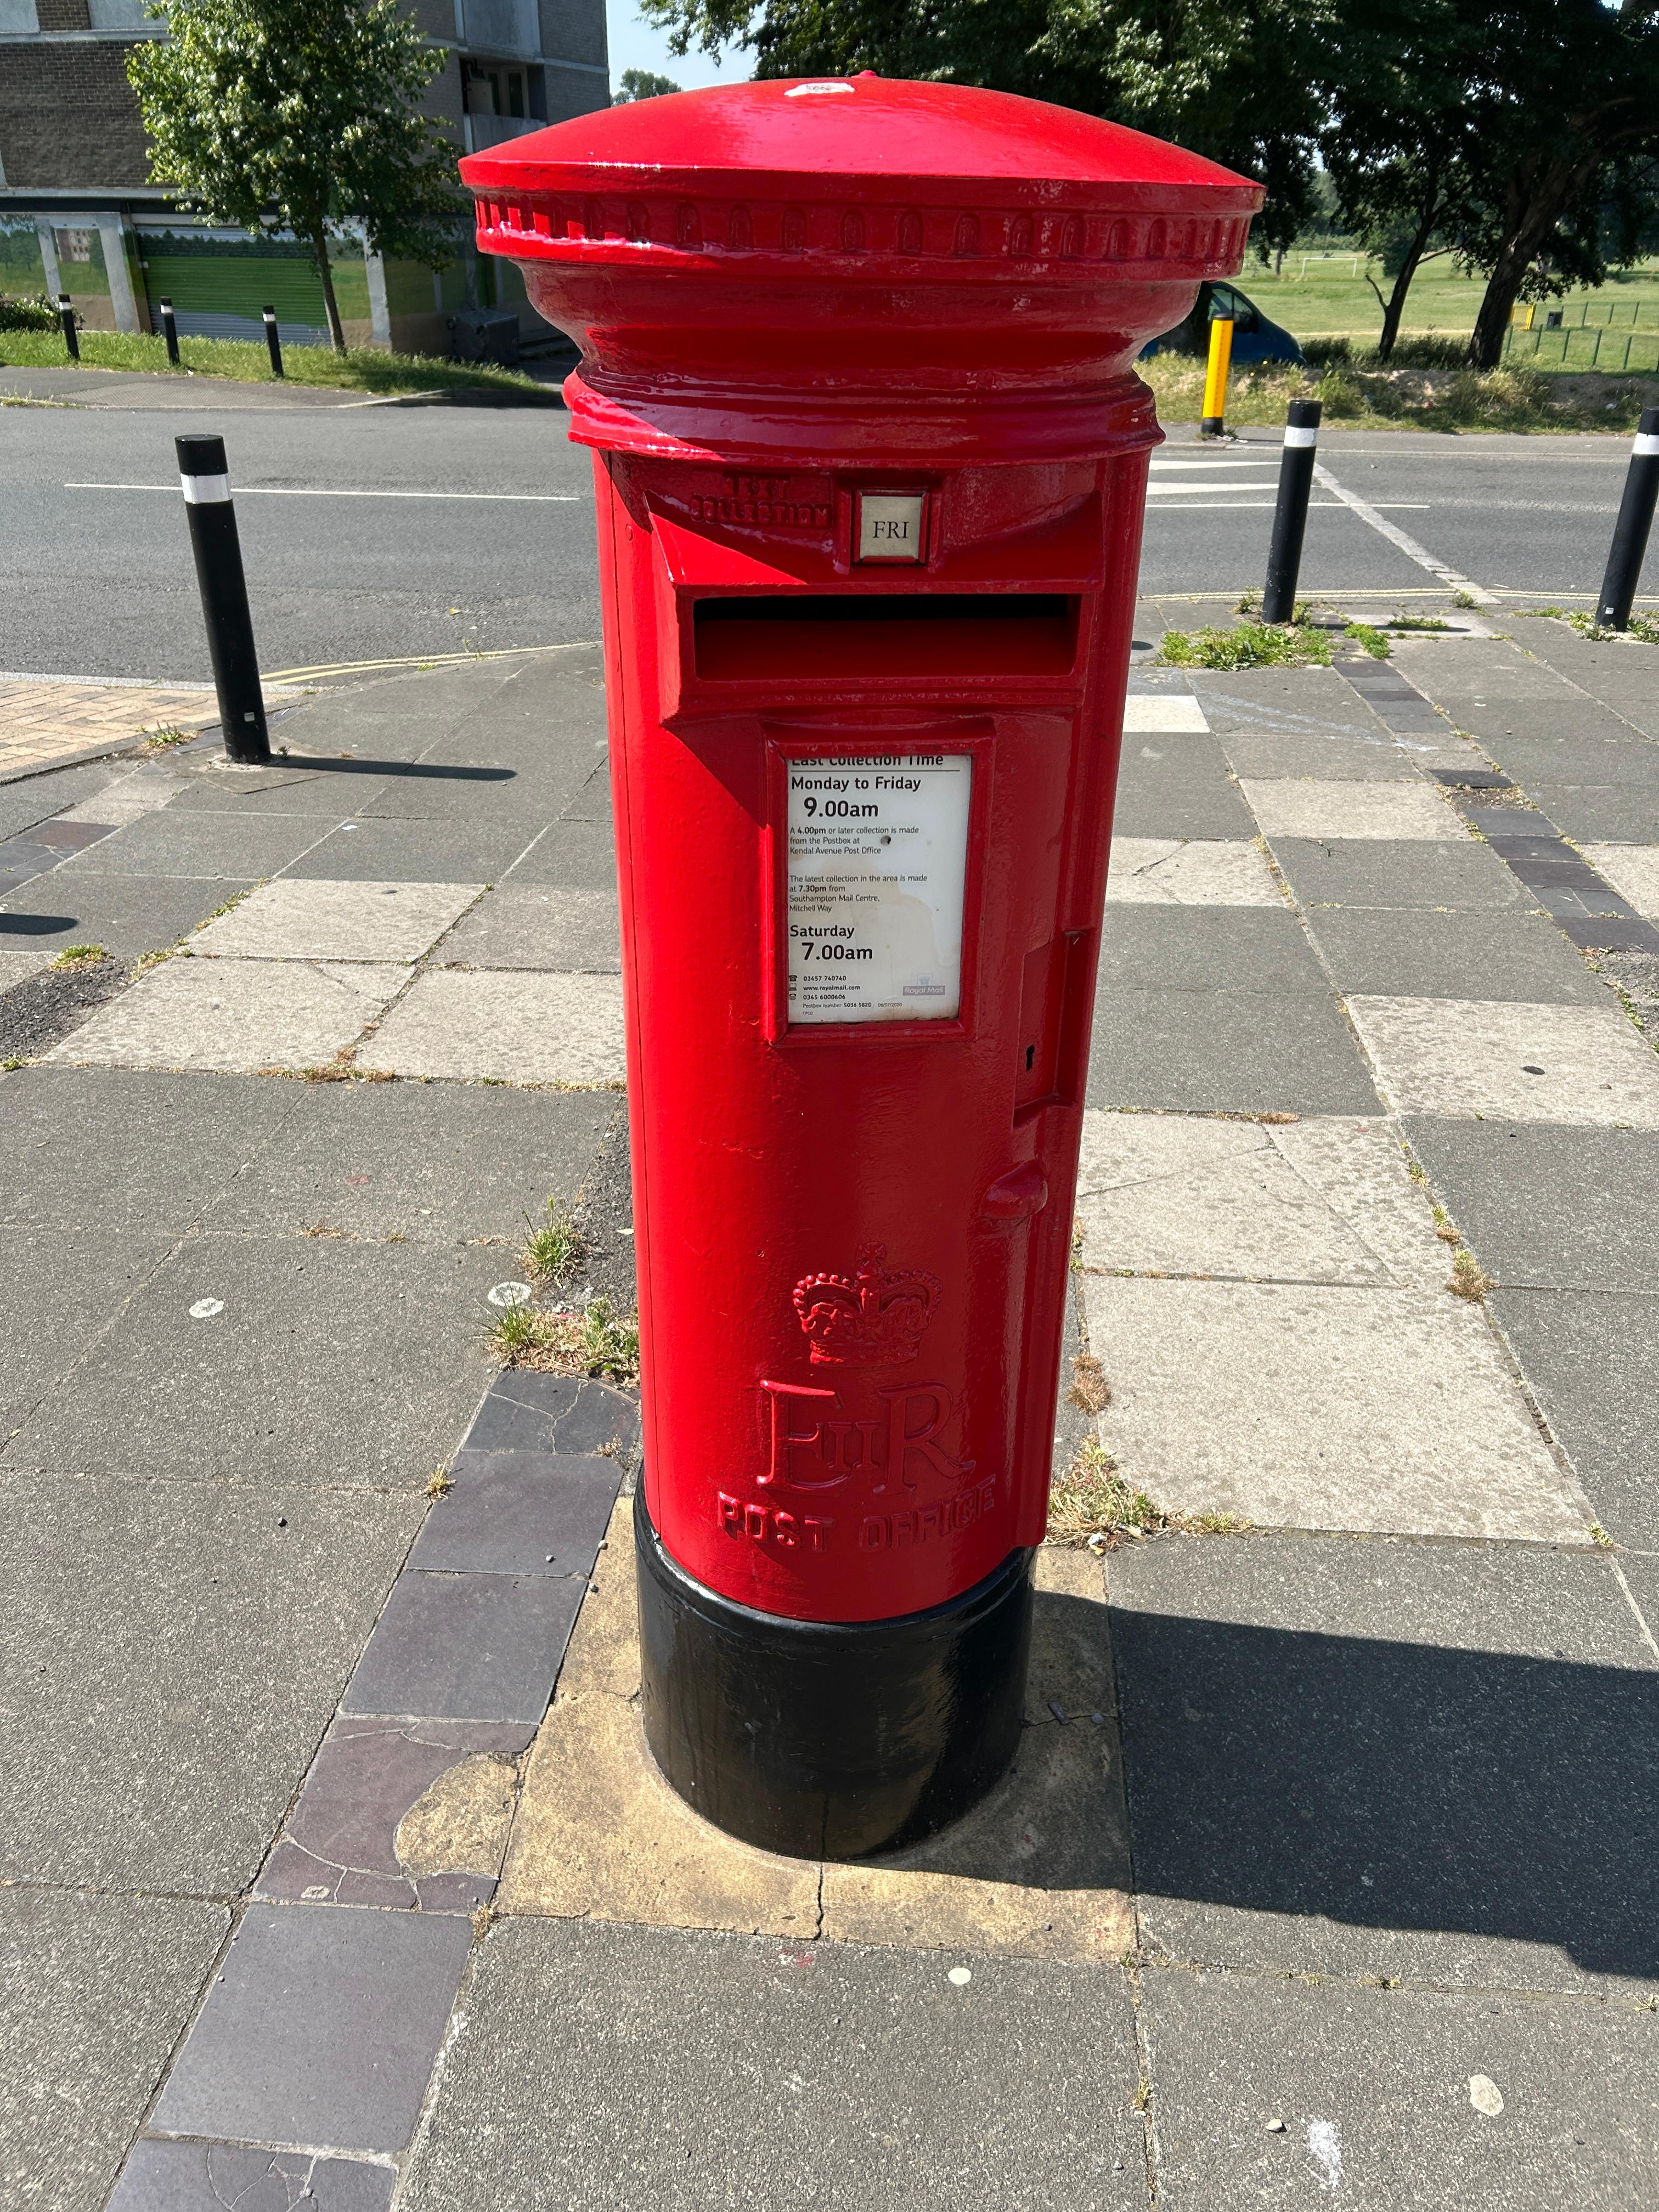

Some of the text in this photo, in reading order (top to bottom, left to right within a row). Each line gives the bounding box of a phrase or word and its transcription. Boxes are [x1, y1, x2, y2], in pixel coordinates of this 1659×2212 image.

[691, 496, 832, 527] COLLECTION
[872, 521, 910, 539] FRI
[791, 776, 921, 792] Monday to Friday
[804, 797, 879, 817] 9.00am
[797, 827, 826, 836] 4.00pm
[823, 837, 851, 845] Postbox
[798, 885, 827, 894] 7.30pm
[789, 895, 837, 904] Southampton
[855, 894, 880, 903] Centre,
[817, 905, 832, 913] Way
[790, 925, 855, 939] Saturday
[801, 942, 873, 961] 7.00am
[717, 1474, 997, 1552] POST OFFICE
